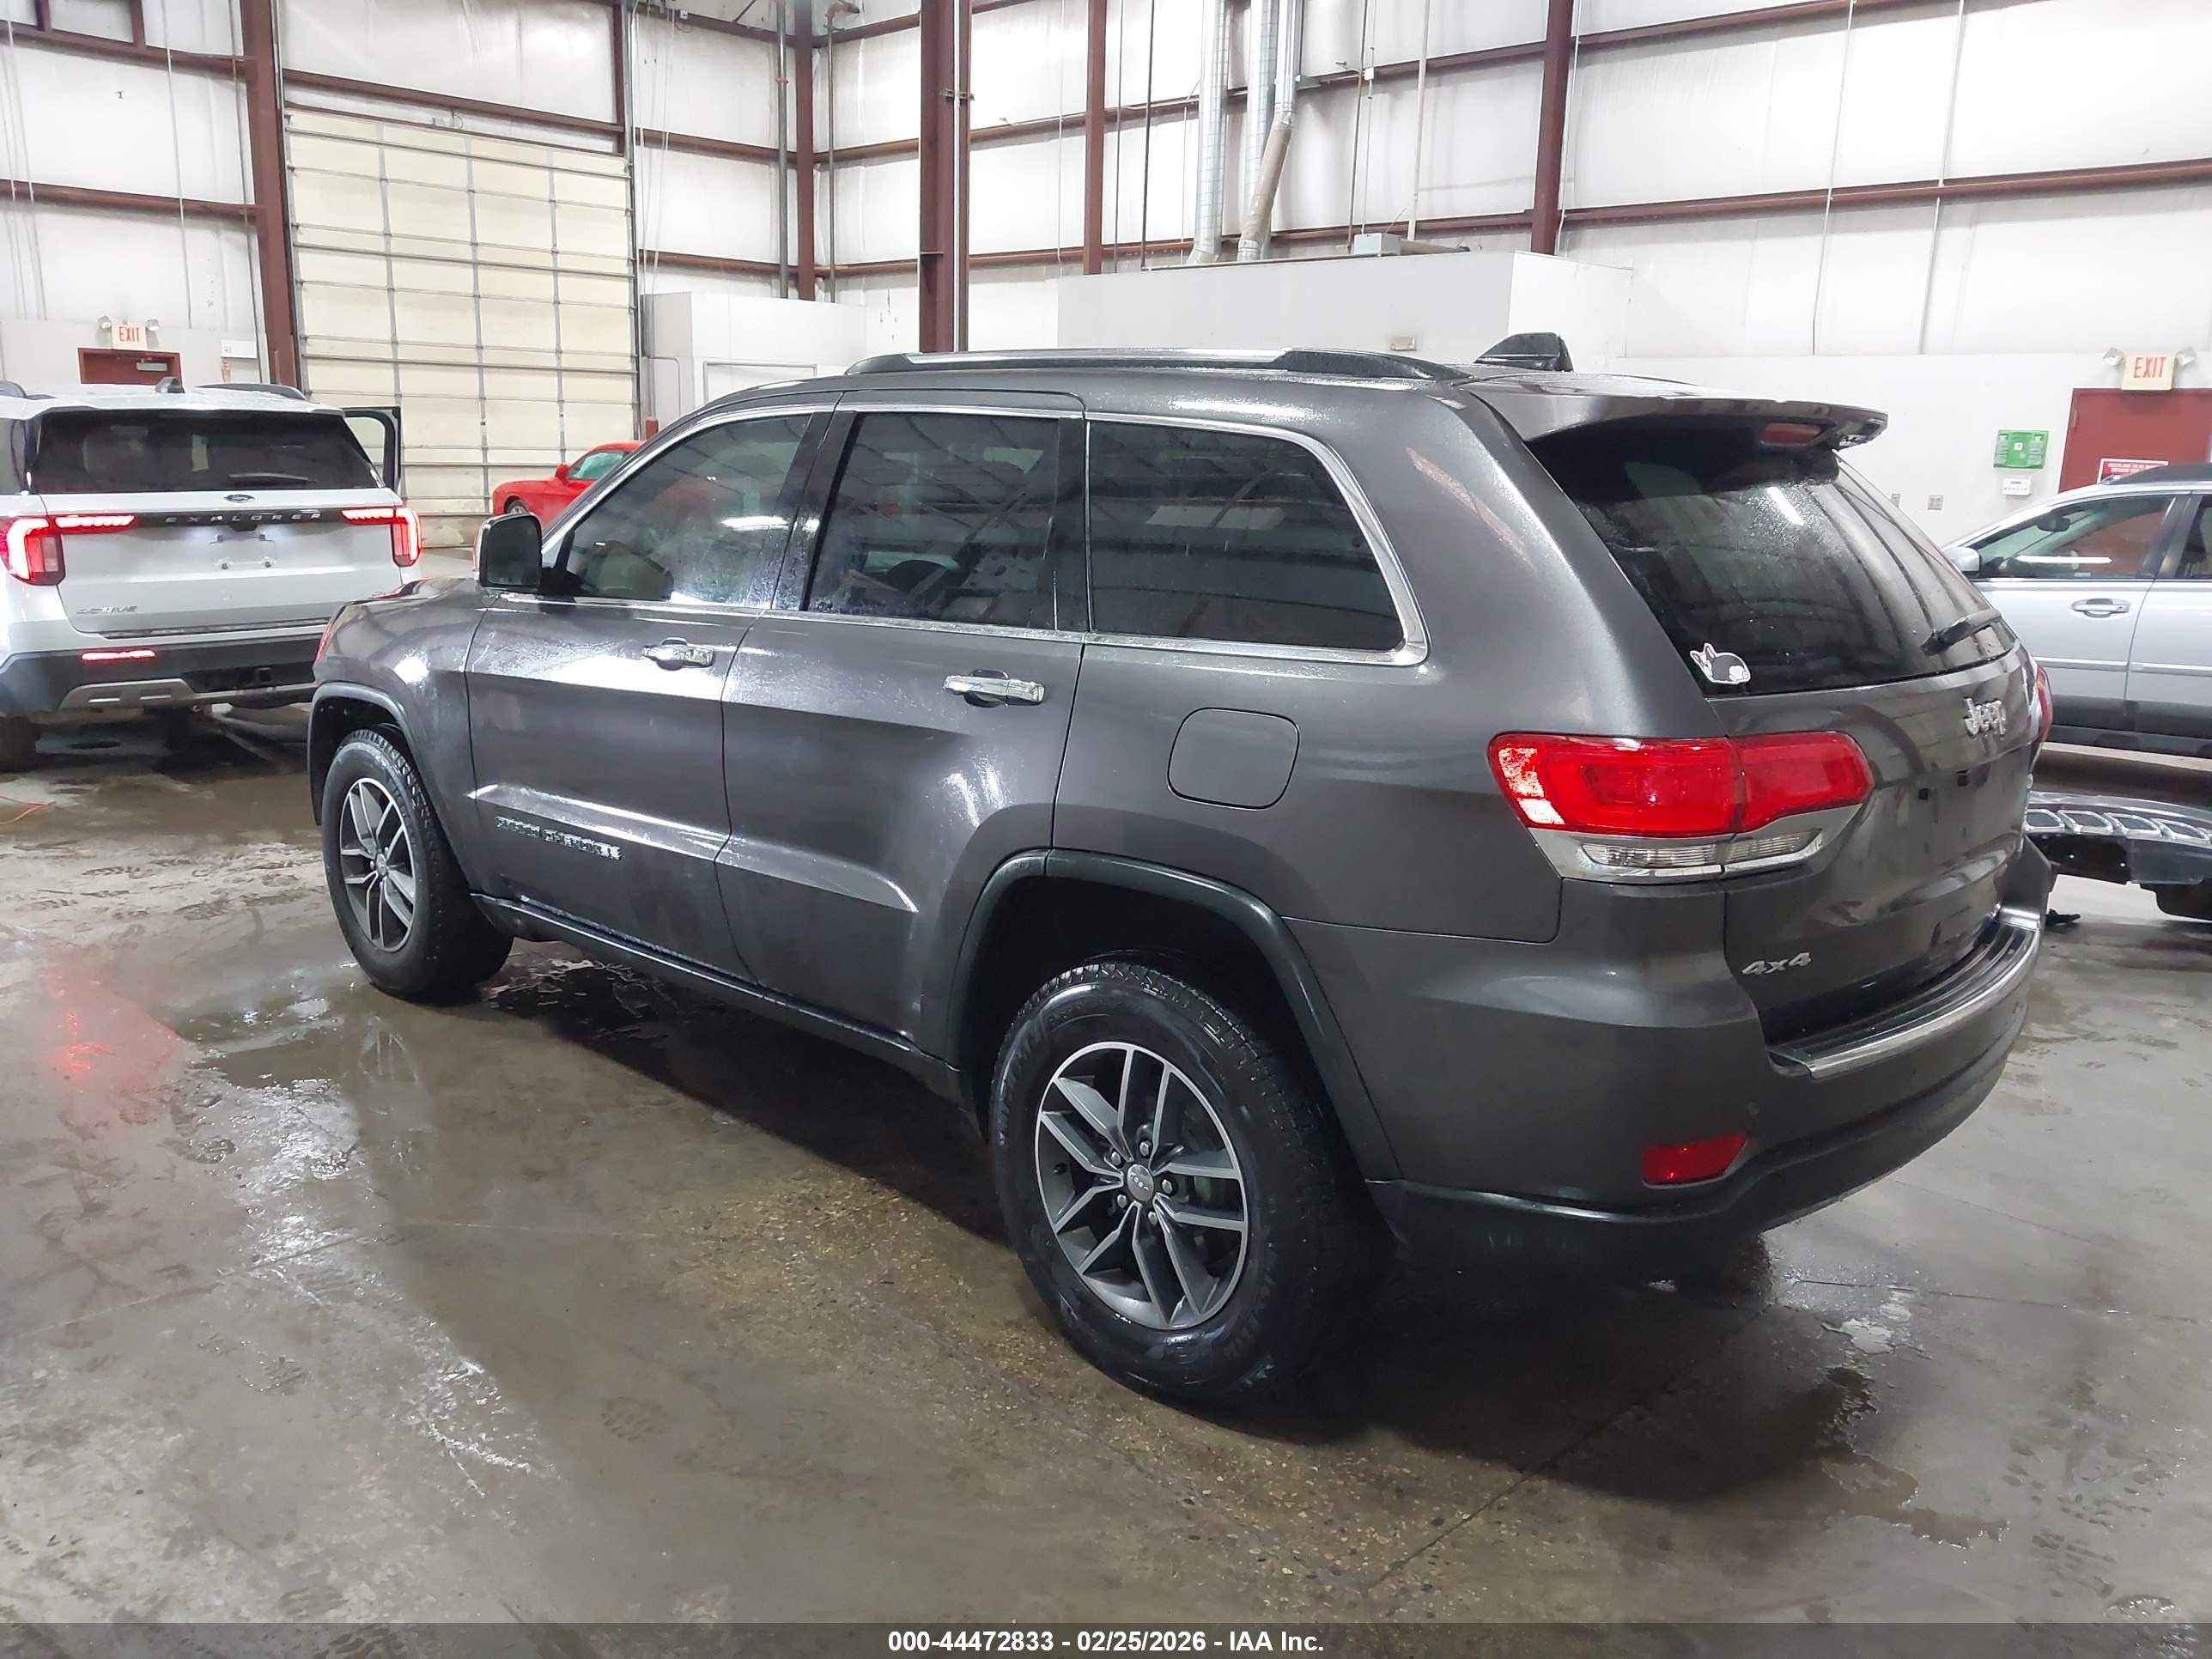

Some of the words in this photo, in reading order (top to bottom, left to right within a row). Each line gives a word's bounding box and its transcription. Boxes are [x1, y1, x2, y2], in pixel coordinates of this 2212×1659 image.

[118, 326, 140, 342] EXIT
[2133, 356, 2167, 379] EXIT
[165, 513, 321, 523] EXPLORER
